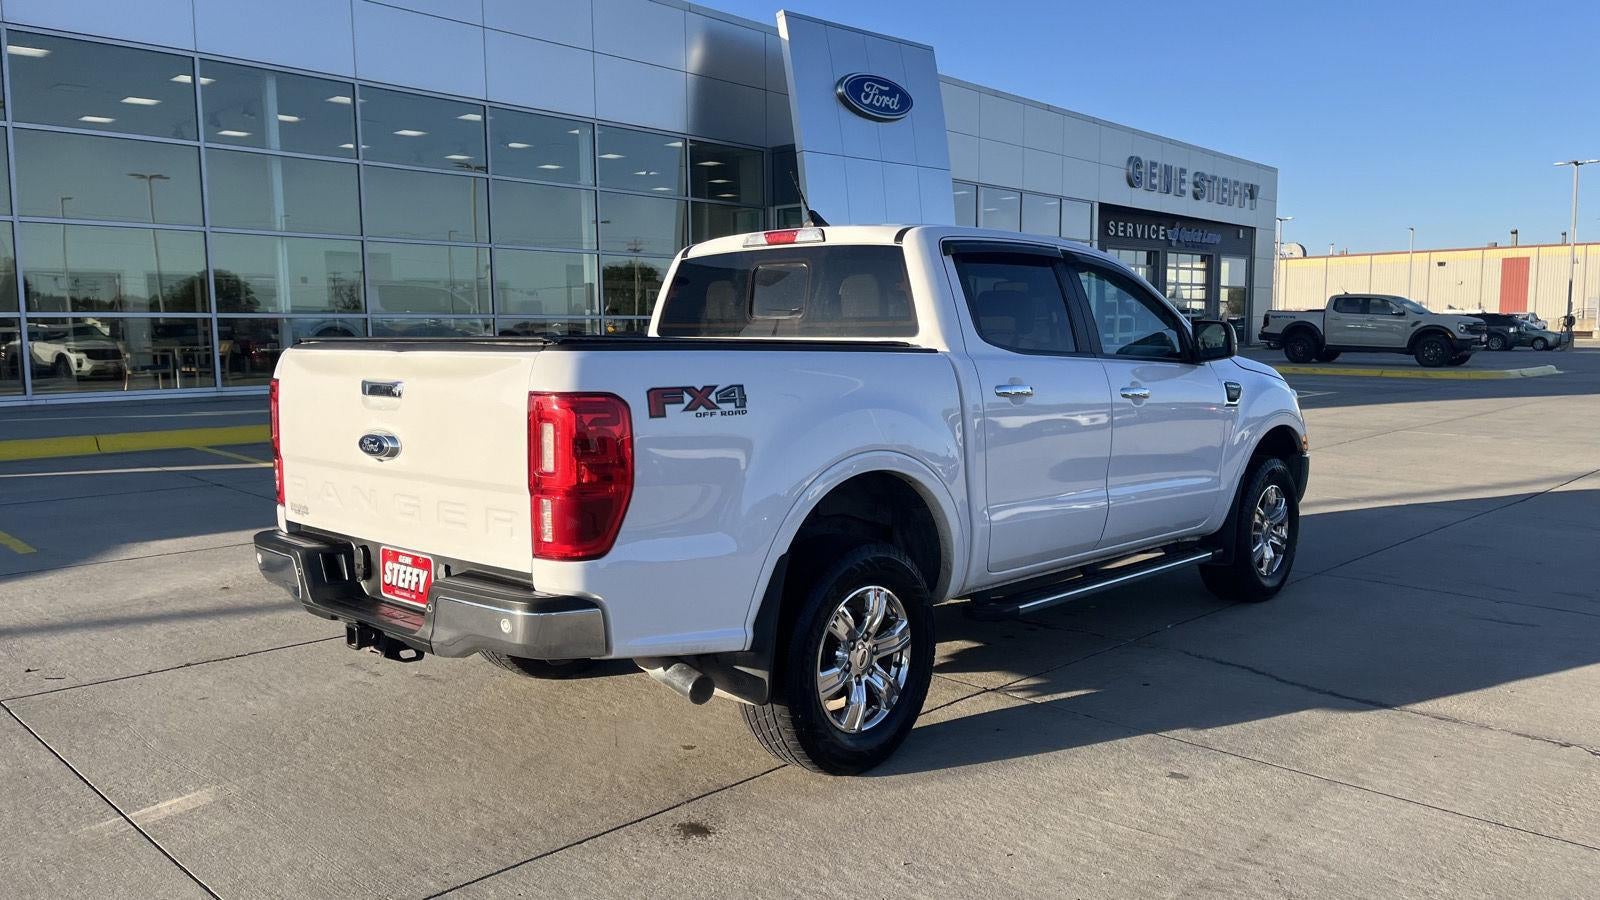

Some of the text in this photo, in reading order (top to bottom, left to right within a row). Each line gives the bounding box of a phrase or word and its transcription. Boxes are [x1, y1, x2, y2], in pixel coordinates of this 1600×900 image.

[861, 81, 900, 110] Ford
[1126, 155, 1260, 210] GENE STEFFY
[1108, 220, 1166, 240] SERVICE
[646, 384, 747, 418] FX4
[720, 409, 748, 417] ROAD
[287, 474, 519, 540] RANGER
[384, 561, 428, 593] STEFFY
